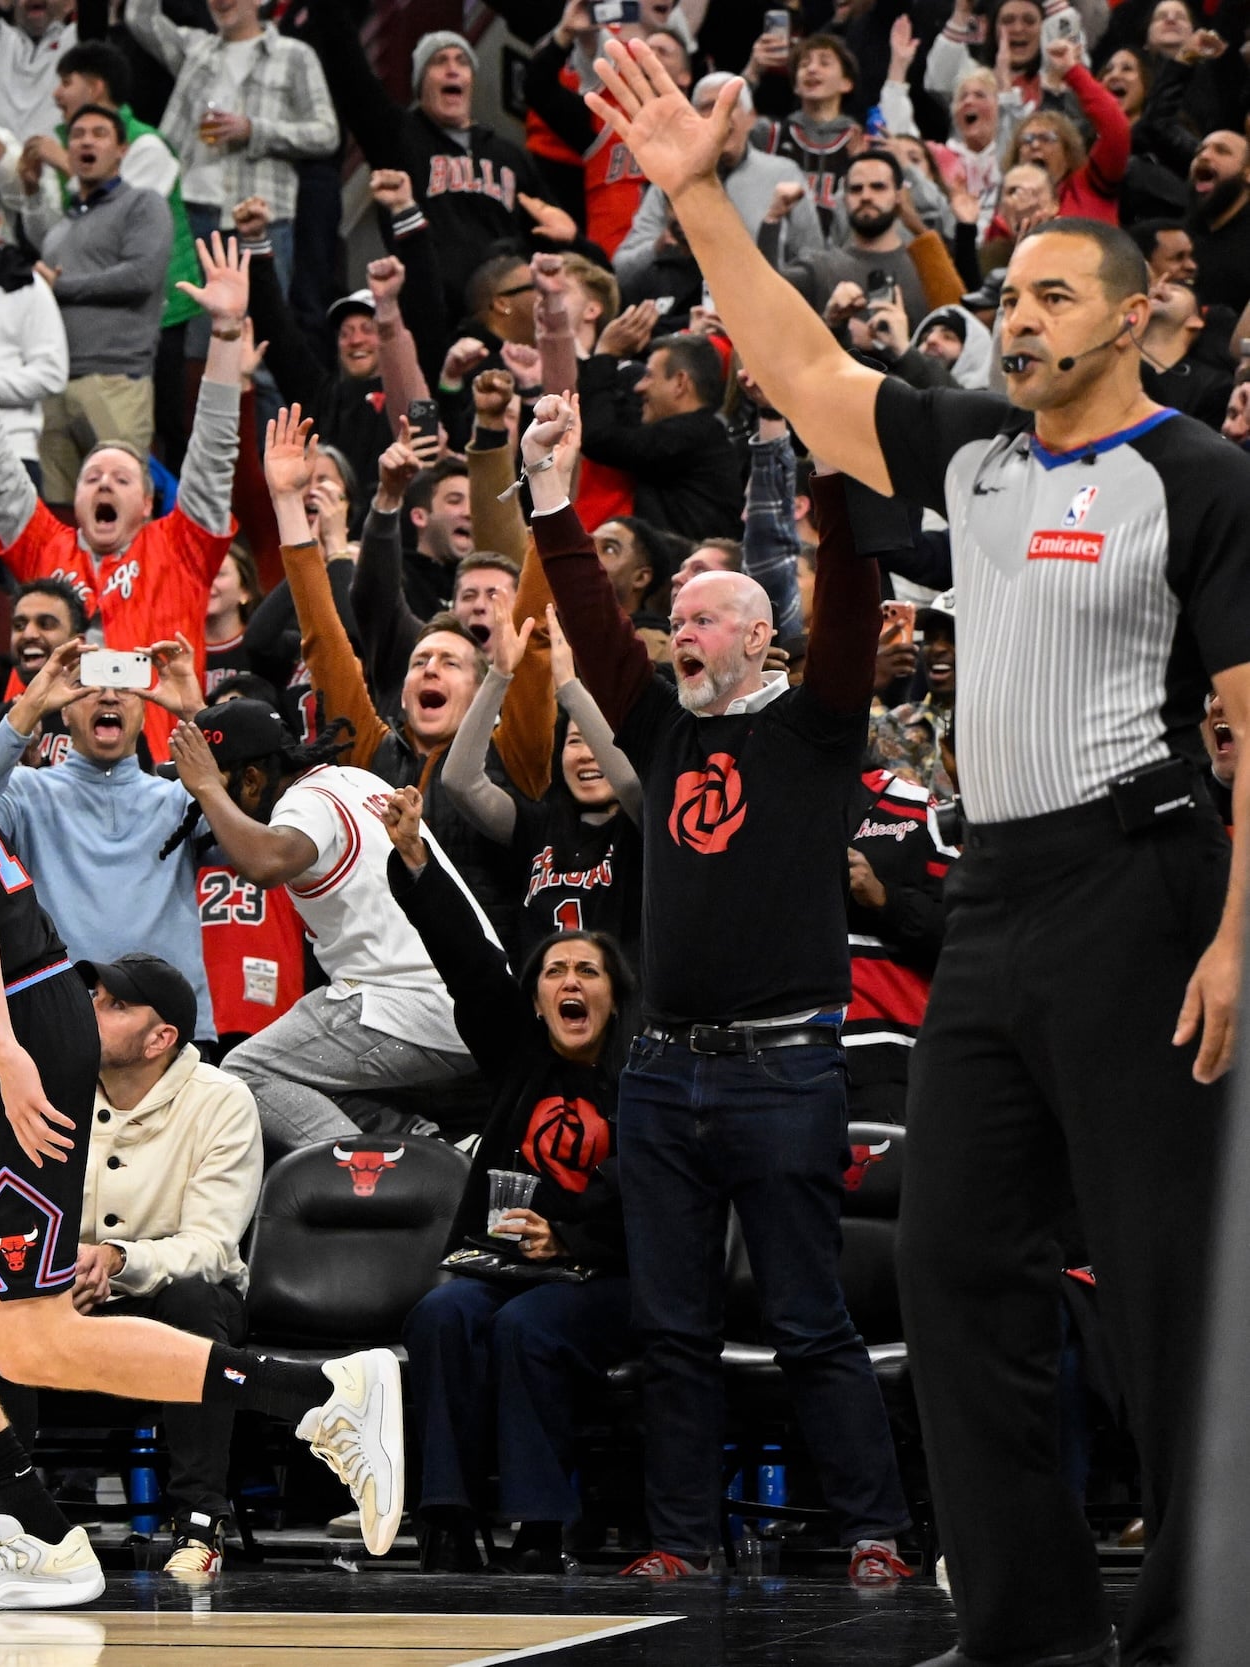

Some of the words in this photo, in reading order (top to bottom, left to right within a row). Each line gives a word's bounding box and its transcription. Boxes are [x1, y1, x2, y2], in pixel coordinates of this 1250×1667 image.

[427, 154, 516, 212] BULLS
[1030, 536, 1100, 556] Emirates
[853, 818, 919, 842] hicago
[199, 871, 267, 926] 23
[553, 898, 583, 933] 1
